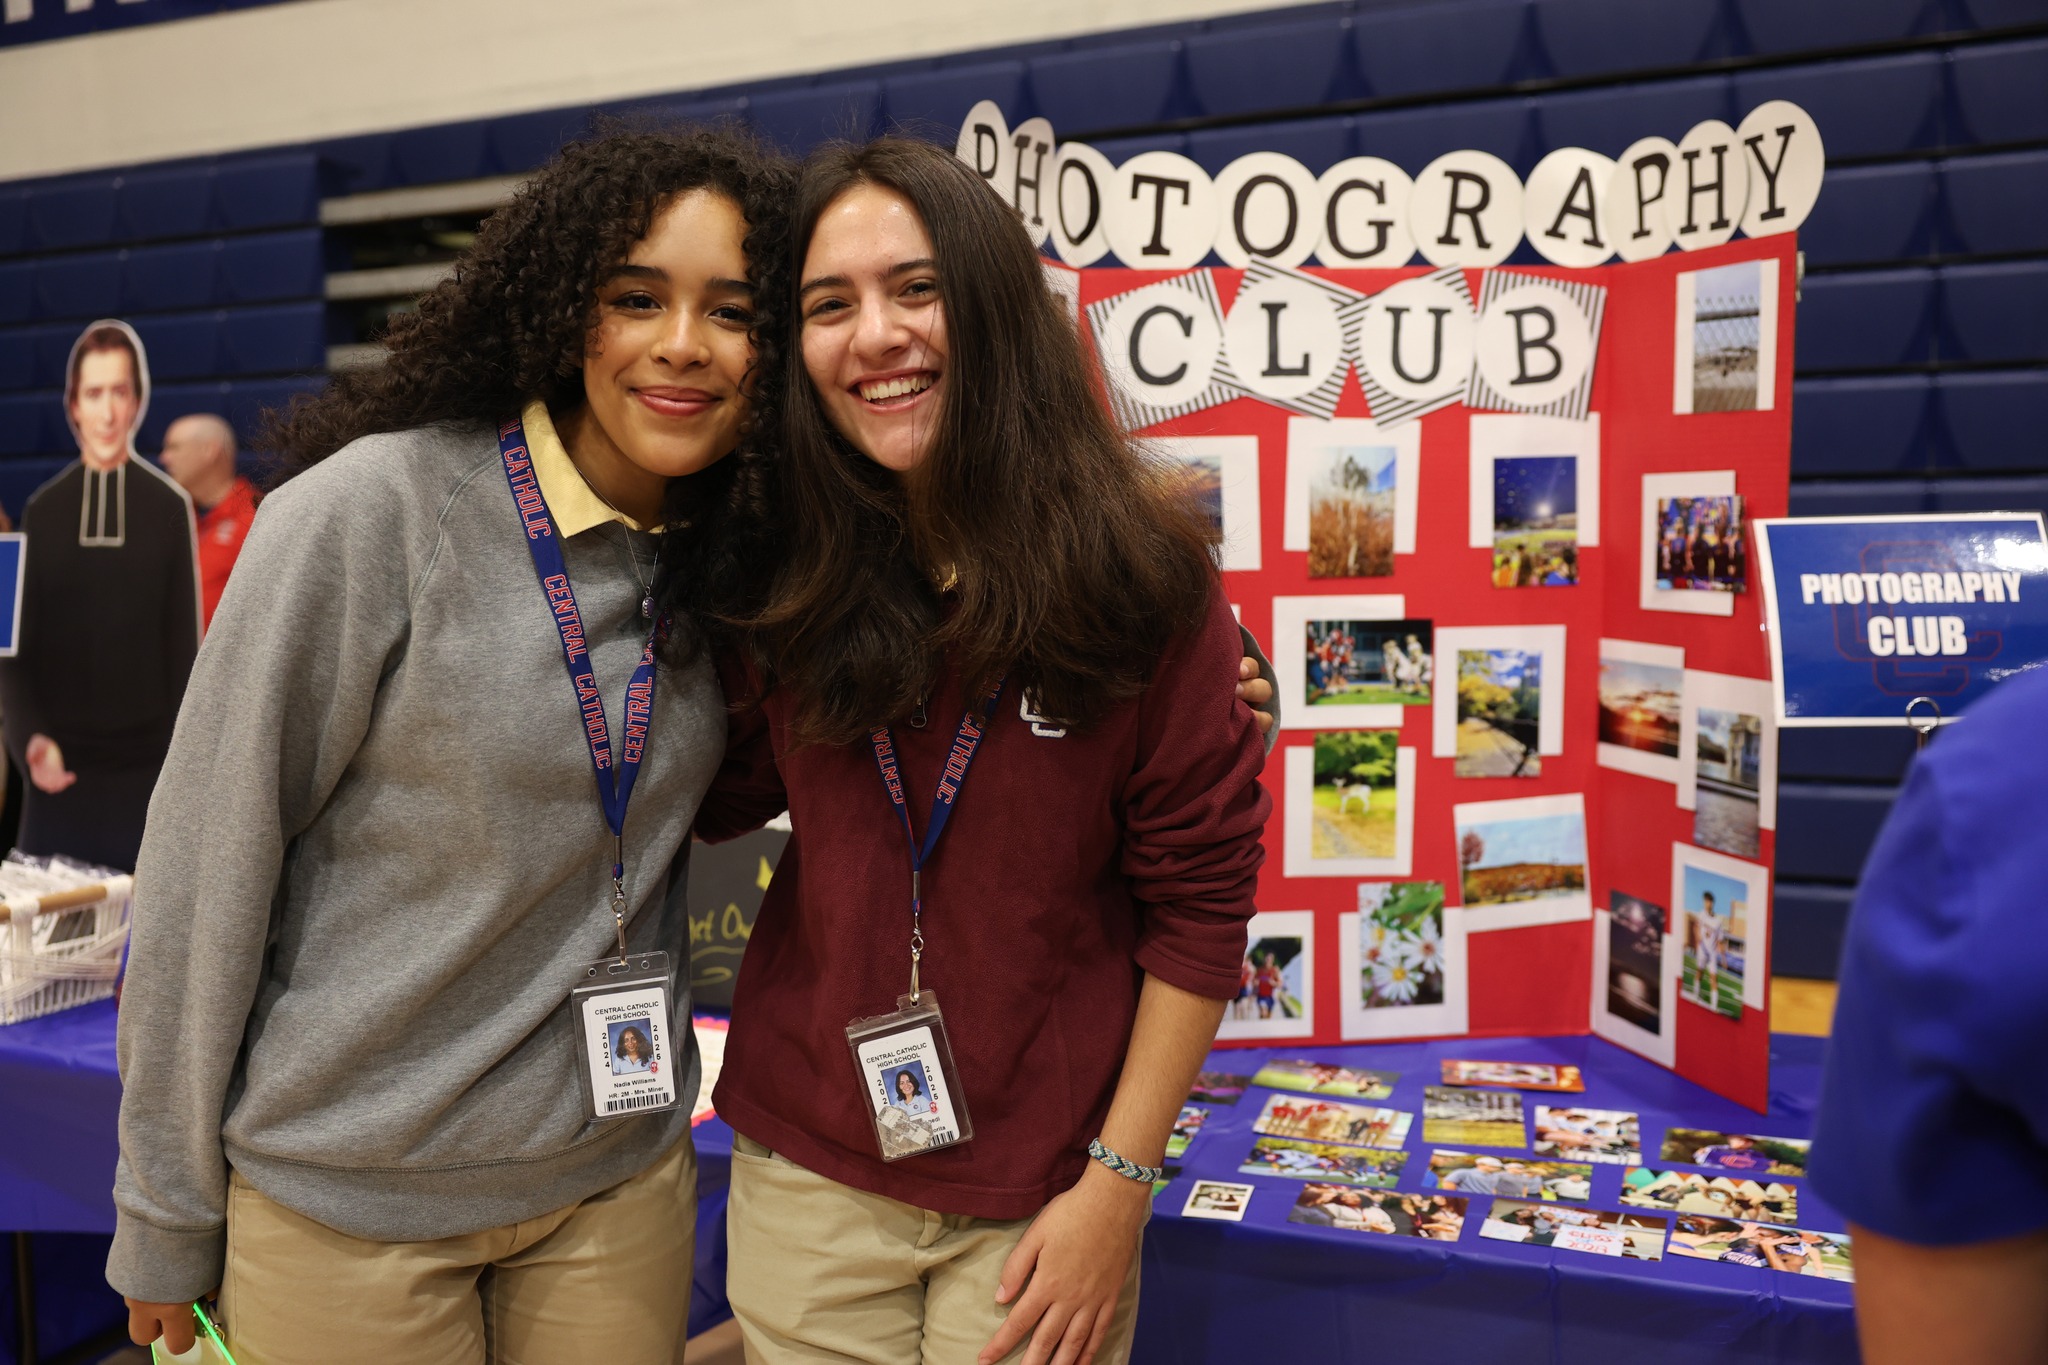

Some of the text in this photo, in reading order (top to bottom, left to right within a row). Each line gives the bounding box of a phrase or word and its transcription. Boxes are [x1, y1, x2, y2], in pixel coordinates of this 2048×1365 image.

[973, 123, 1796, 260] PHOTOGRAPHY
[1129, 302, 1563, 386] CLUB
[1800, 571, 2022, 605] PHOTOGRAPHY
[504, 445, 552, 540] CATHOLIC
[543, 573, 587, 664] CENTRAL
[575, 672, 611, 770] CATHOLIC
[1867, 615, 1968, 656] CLUB
[624, 676, 653, 764] CENTRAL
[594, 1000, 660, 1016] CENTRAL CATHOLIC
[605, 1010, 651, 1022] HIGH SCHOOL
[866, 1042, 928, 1064] CENTRAL CATHOLIC
[877, 1052, 921, 1069] HIGH SCHOOL
[631, 1078, 656, 1086] Williams
